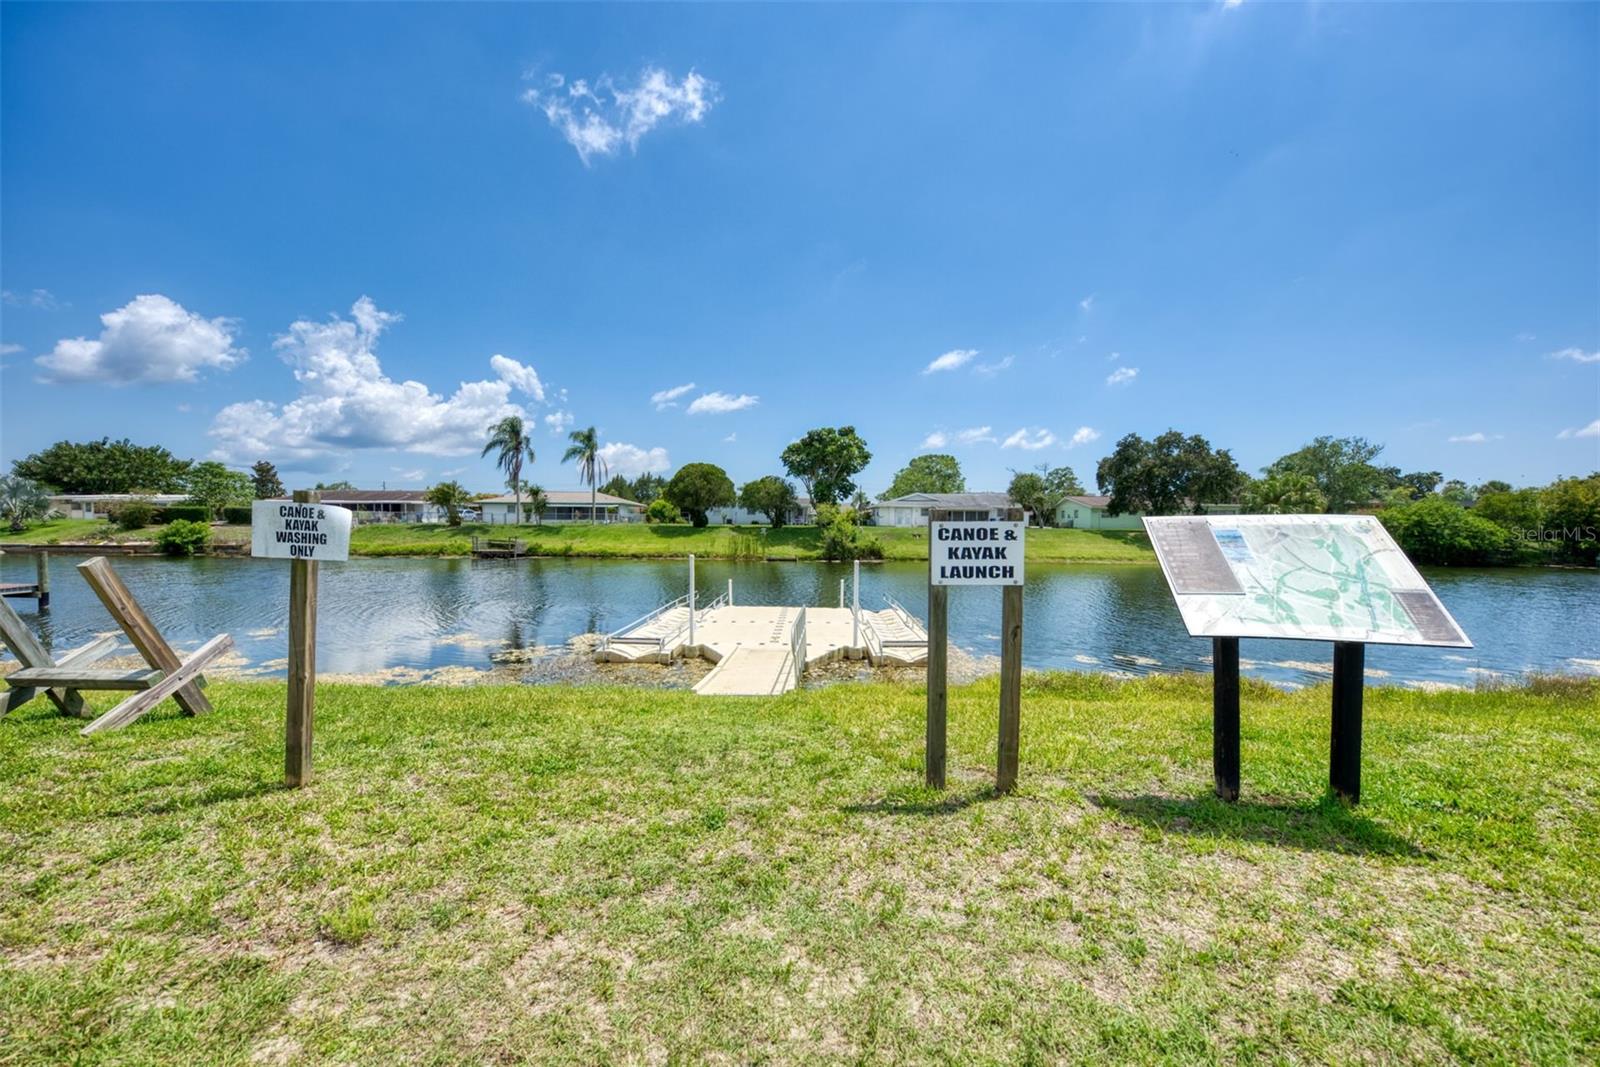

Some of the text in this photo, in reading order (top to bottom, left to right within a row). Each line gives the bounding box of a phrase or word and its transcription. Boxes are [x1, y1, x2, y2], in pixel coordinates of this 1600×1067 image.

[279, 505, 326, 520] CANOE &
[285, 519, 319, 532] KAYAK
[276, 531, 328, 545] WASHING
[938, 527, 1018, 541] CANOE &
[290, 544, 316, 557] ONLY
[948, 546, 1007, 560] KAYAK
[940, 565, 1015, 579] LAUNCH
